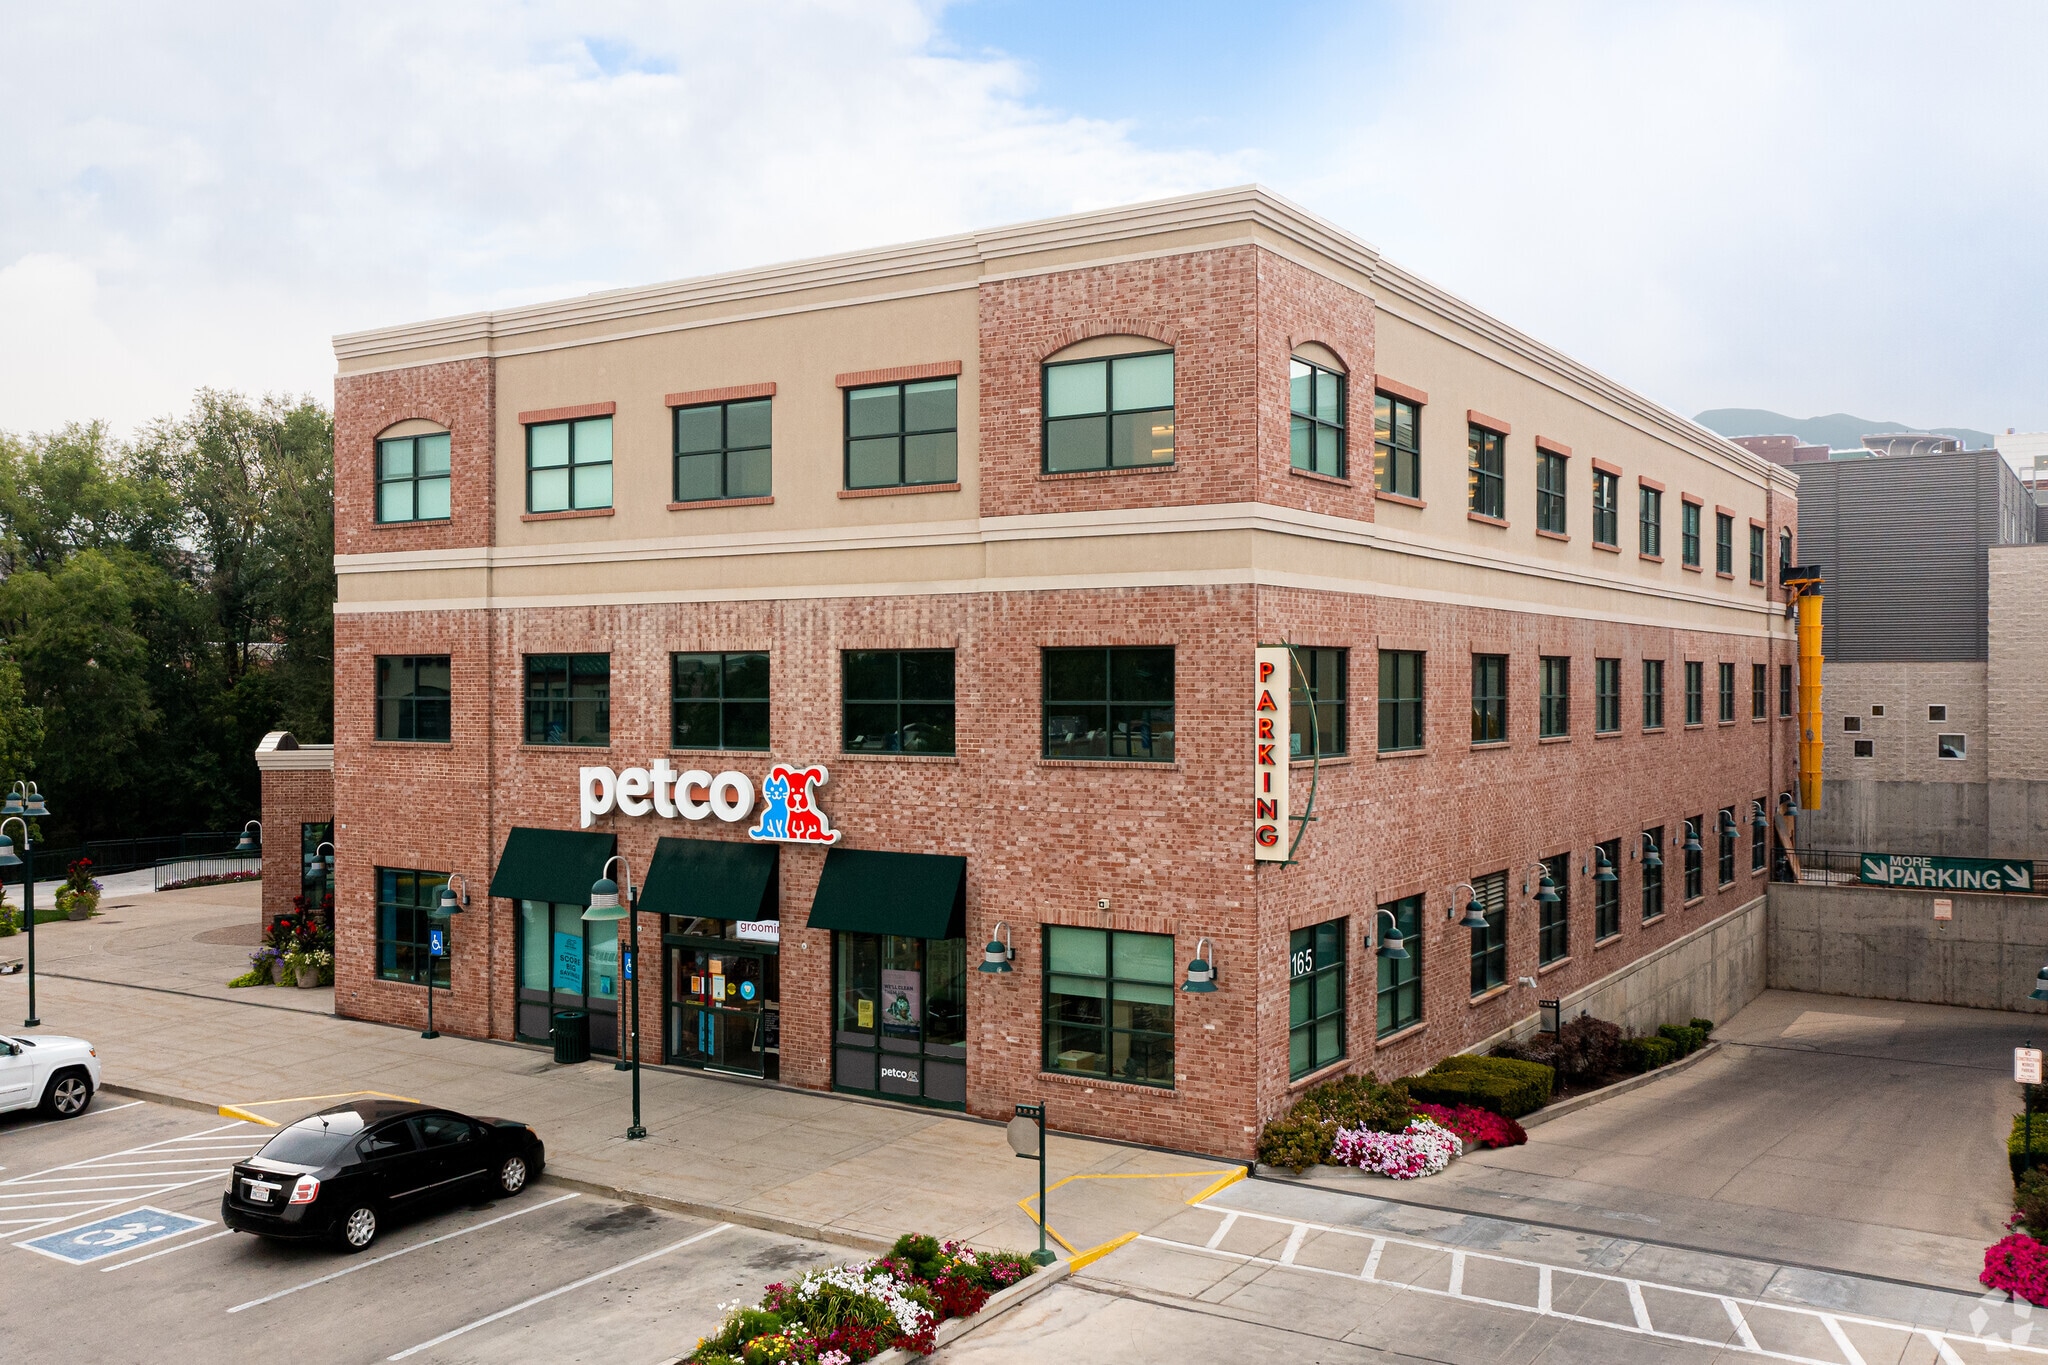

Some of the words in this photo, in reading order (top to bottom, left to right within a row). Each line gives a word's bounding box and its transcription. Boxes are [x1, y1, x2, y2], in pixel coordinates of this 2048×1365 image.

[1256, 661, 1279, 848] PARKING
[579, 758, 756, 829] petco
[1889, 855, 1932, 868] MORE
[1889, 866, 2002, 890] PARKING
[560, 954, 581, 966] SCORE
[566, 963, 577, 972] BIG
[1291, 948, 1313, 977] 165
[881, 1067, 908, 1079] petco
